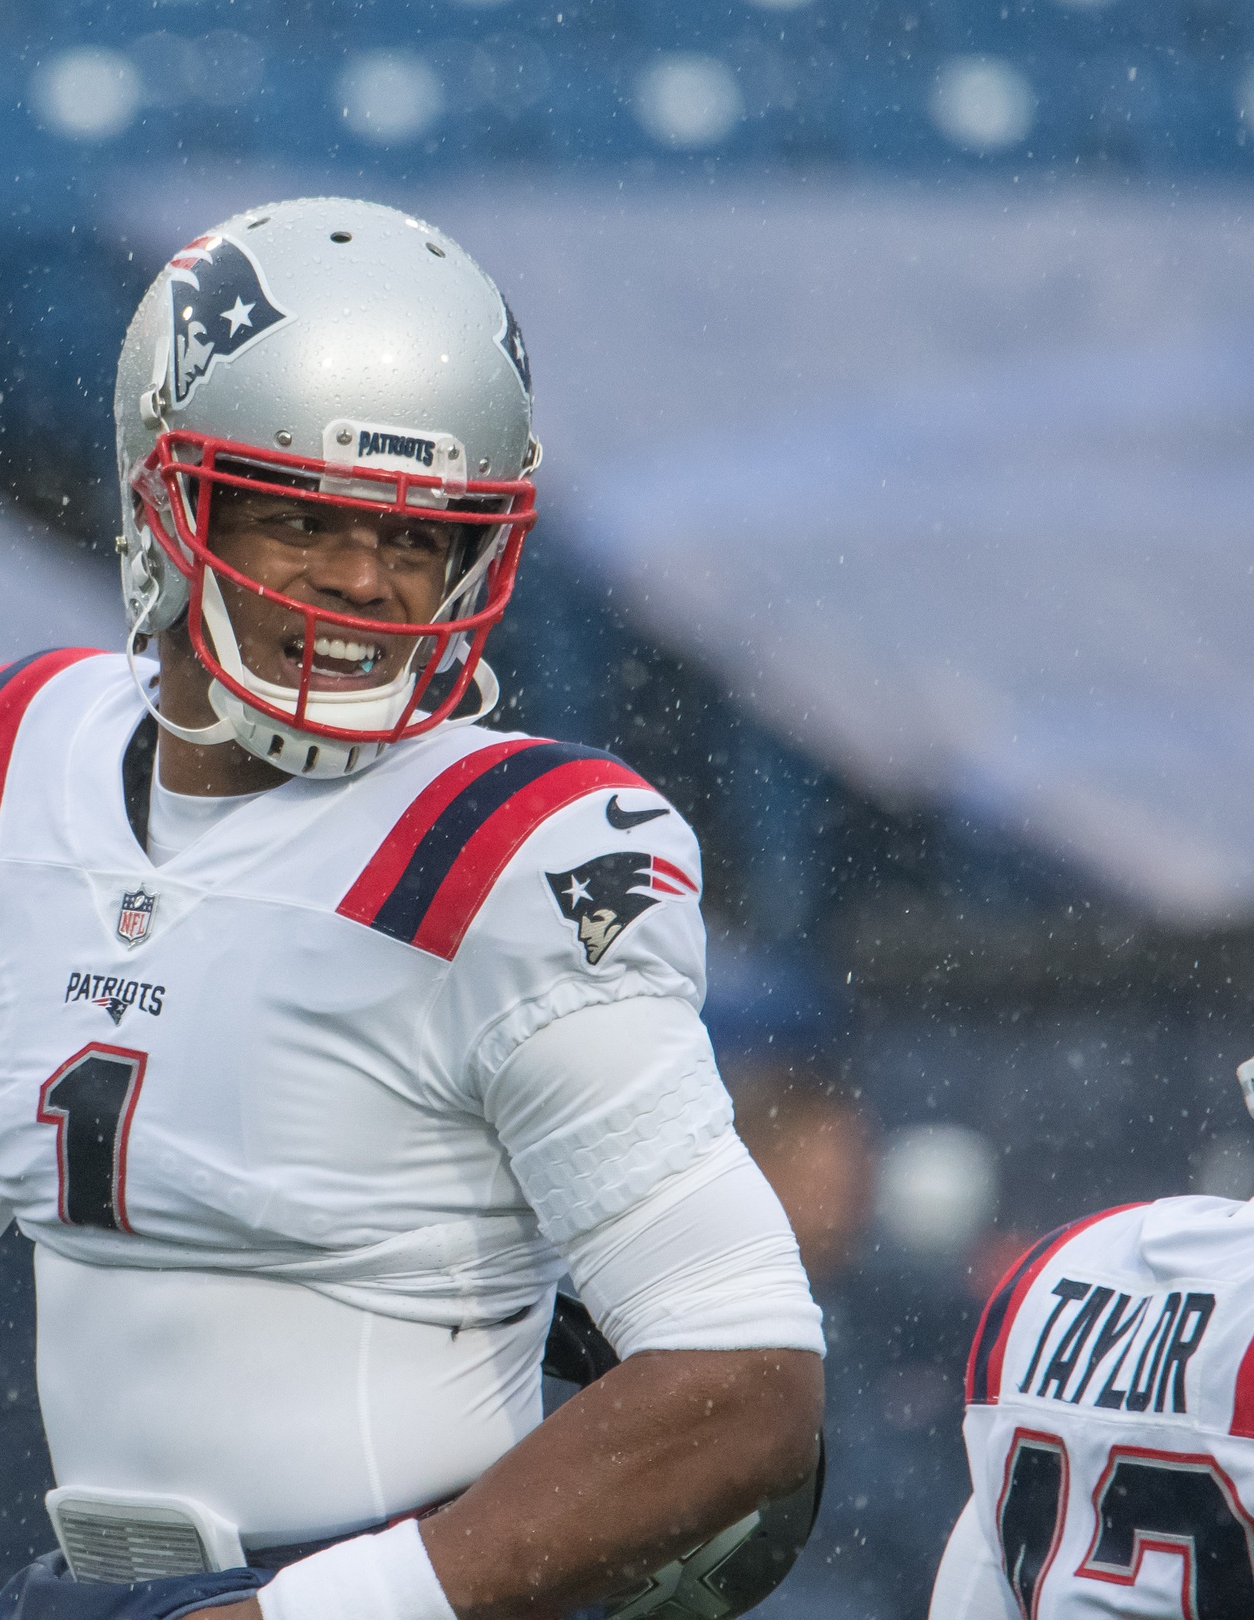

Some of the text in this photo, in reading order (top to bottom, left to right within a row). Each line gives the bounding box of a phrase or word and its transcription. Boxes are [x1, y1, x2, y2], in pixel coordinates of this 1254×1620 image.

[358, 430, 436, 467] PATRIOTS
[120, 911, 146, 938] NFL
[65, 972, 166, 1016] PATRIOTS
[37, 1041, 149, 1233] 1
[1016, 1277, 1217, 1414] TAYLOR
